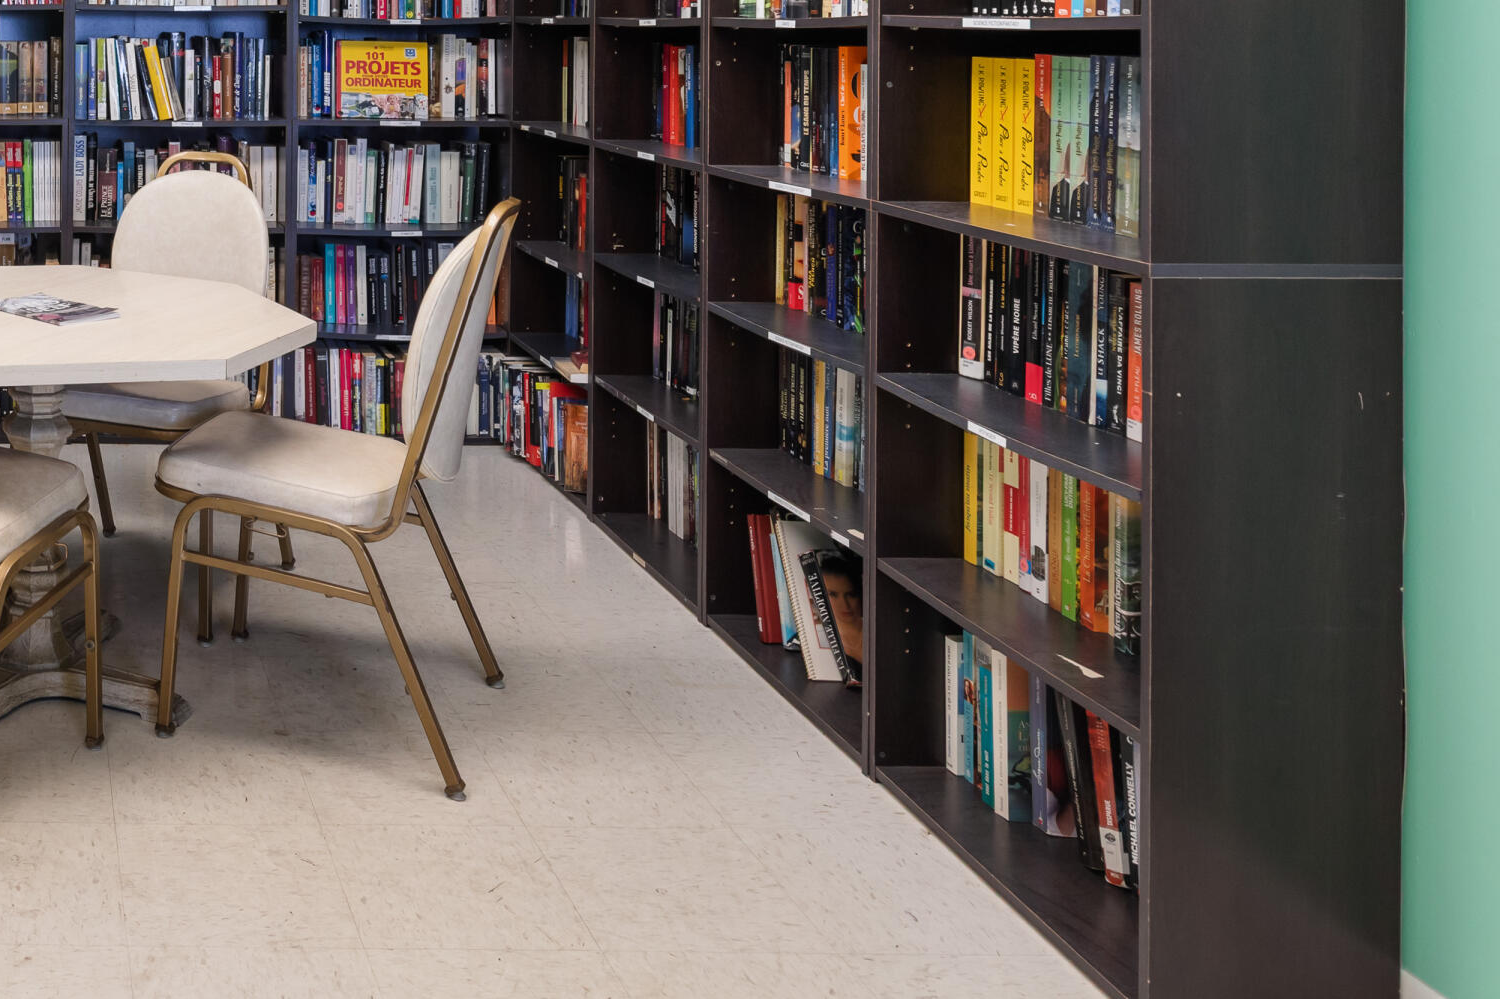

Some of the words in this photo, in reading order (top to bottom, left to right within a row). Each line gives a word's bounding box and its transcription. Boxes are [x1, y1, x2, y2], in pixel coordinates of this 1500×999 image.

[345, 60, 421, 76] PROJETS
[365, 51, 385, 61] 101
[345, 77, 422, 89] ORDINATEUR
[977, 77, 985, 107] ROWLING
[1022, 80, 1030, 111] ROWLING
[75, 139, 85, 157] BOSS
[75, 158, 85, 177] LADY
[100, 185, 108, 209] PRINCE
[966, 299, 974, 321] WILSON
[1012, 297, 1021, 324] NOIRE
[1133, 288, 1142, 326] ROLLINS
[1011, 325, 1021, 354] VIPÈRE
[1097, 327, 1105, 366] SHACK
[1133, 326, 1142, 356] JAMES
[1045, 341, 1053, 366] LUNE
[1045, 366, 1053, 378] de
[1044, 378, 1053, 402] Filles
[809, 571, 833, 623] ADOPTIVE
[826, 622, 841, 655] FILLE
[1124, 761, 1137, 816] CONNELLY
[1125, 817, 1140, 865] MICHAEL
